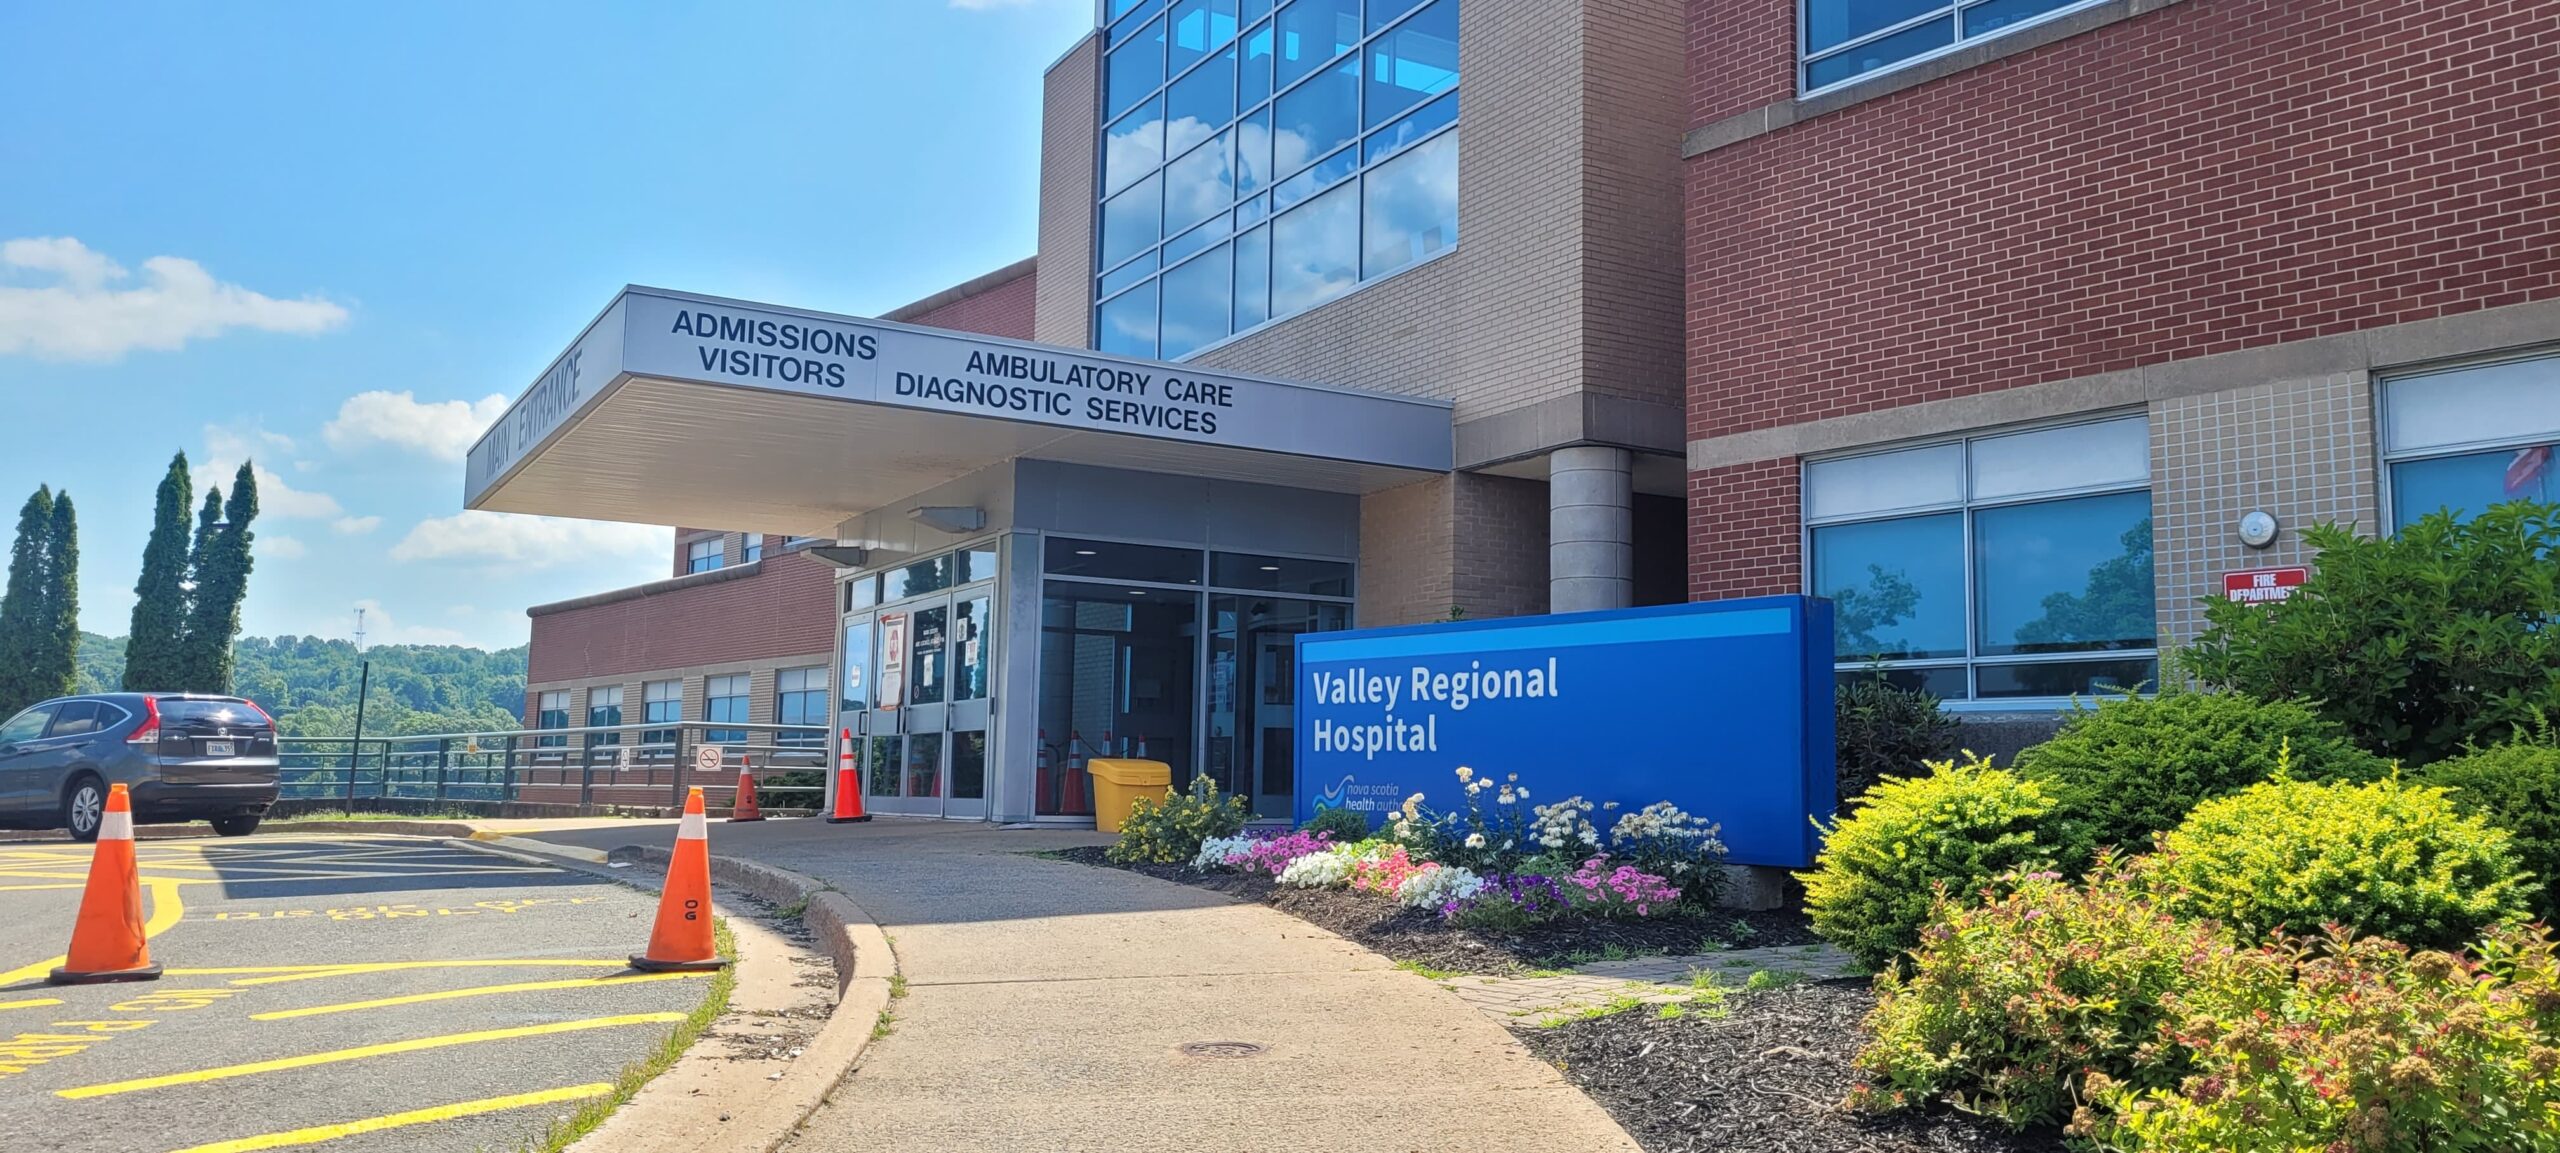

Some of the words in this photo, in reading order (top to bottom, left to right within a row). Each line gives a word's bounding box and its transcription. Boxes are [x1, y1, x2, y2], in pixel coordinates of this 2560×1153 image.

[671, 309, 878, 360] ADMISSIONS
[698, 345, 845, 389] VISITORS
[966, 350, 1152, 396] AMBULATORY
[1164, 377, 1234, 408] CARE
[486, 419, 511, 480] MAIN
[518, 348, 583, 451] ENTRANCE
[895, 371, 1072, 417] DIAGNOSTIC
[1086, 396, 1217, 435] SERVICES
[2252, 573, 2277, 587] FIRE
[1313, 667, 1402, 712] Valley
[1411, 657, 1558, 710] Regional
[1314, 714, 1437, 760] Hospital
[1345, 797, 1375, 811] health
[1347, 784, 1369, 796] nova
[1371, 783, 1399, 796] scotia
